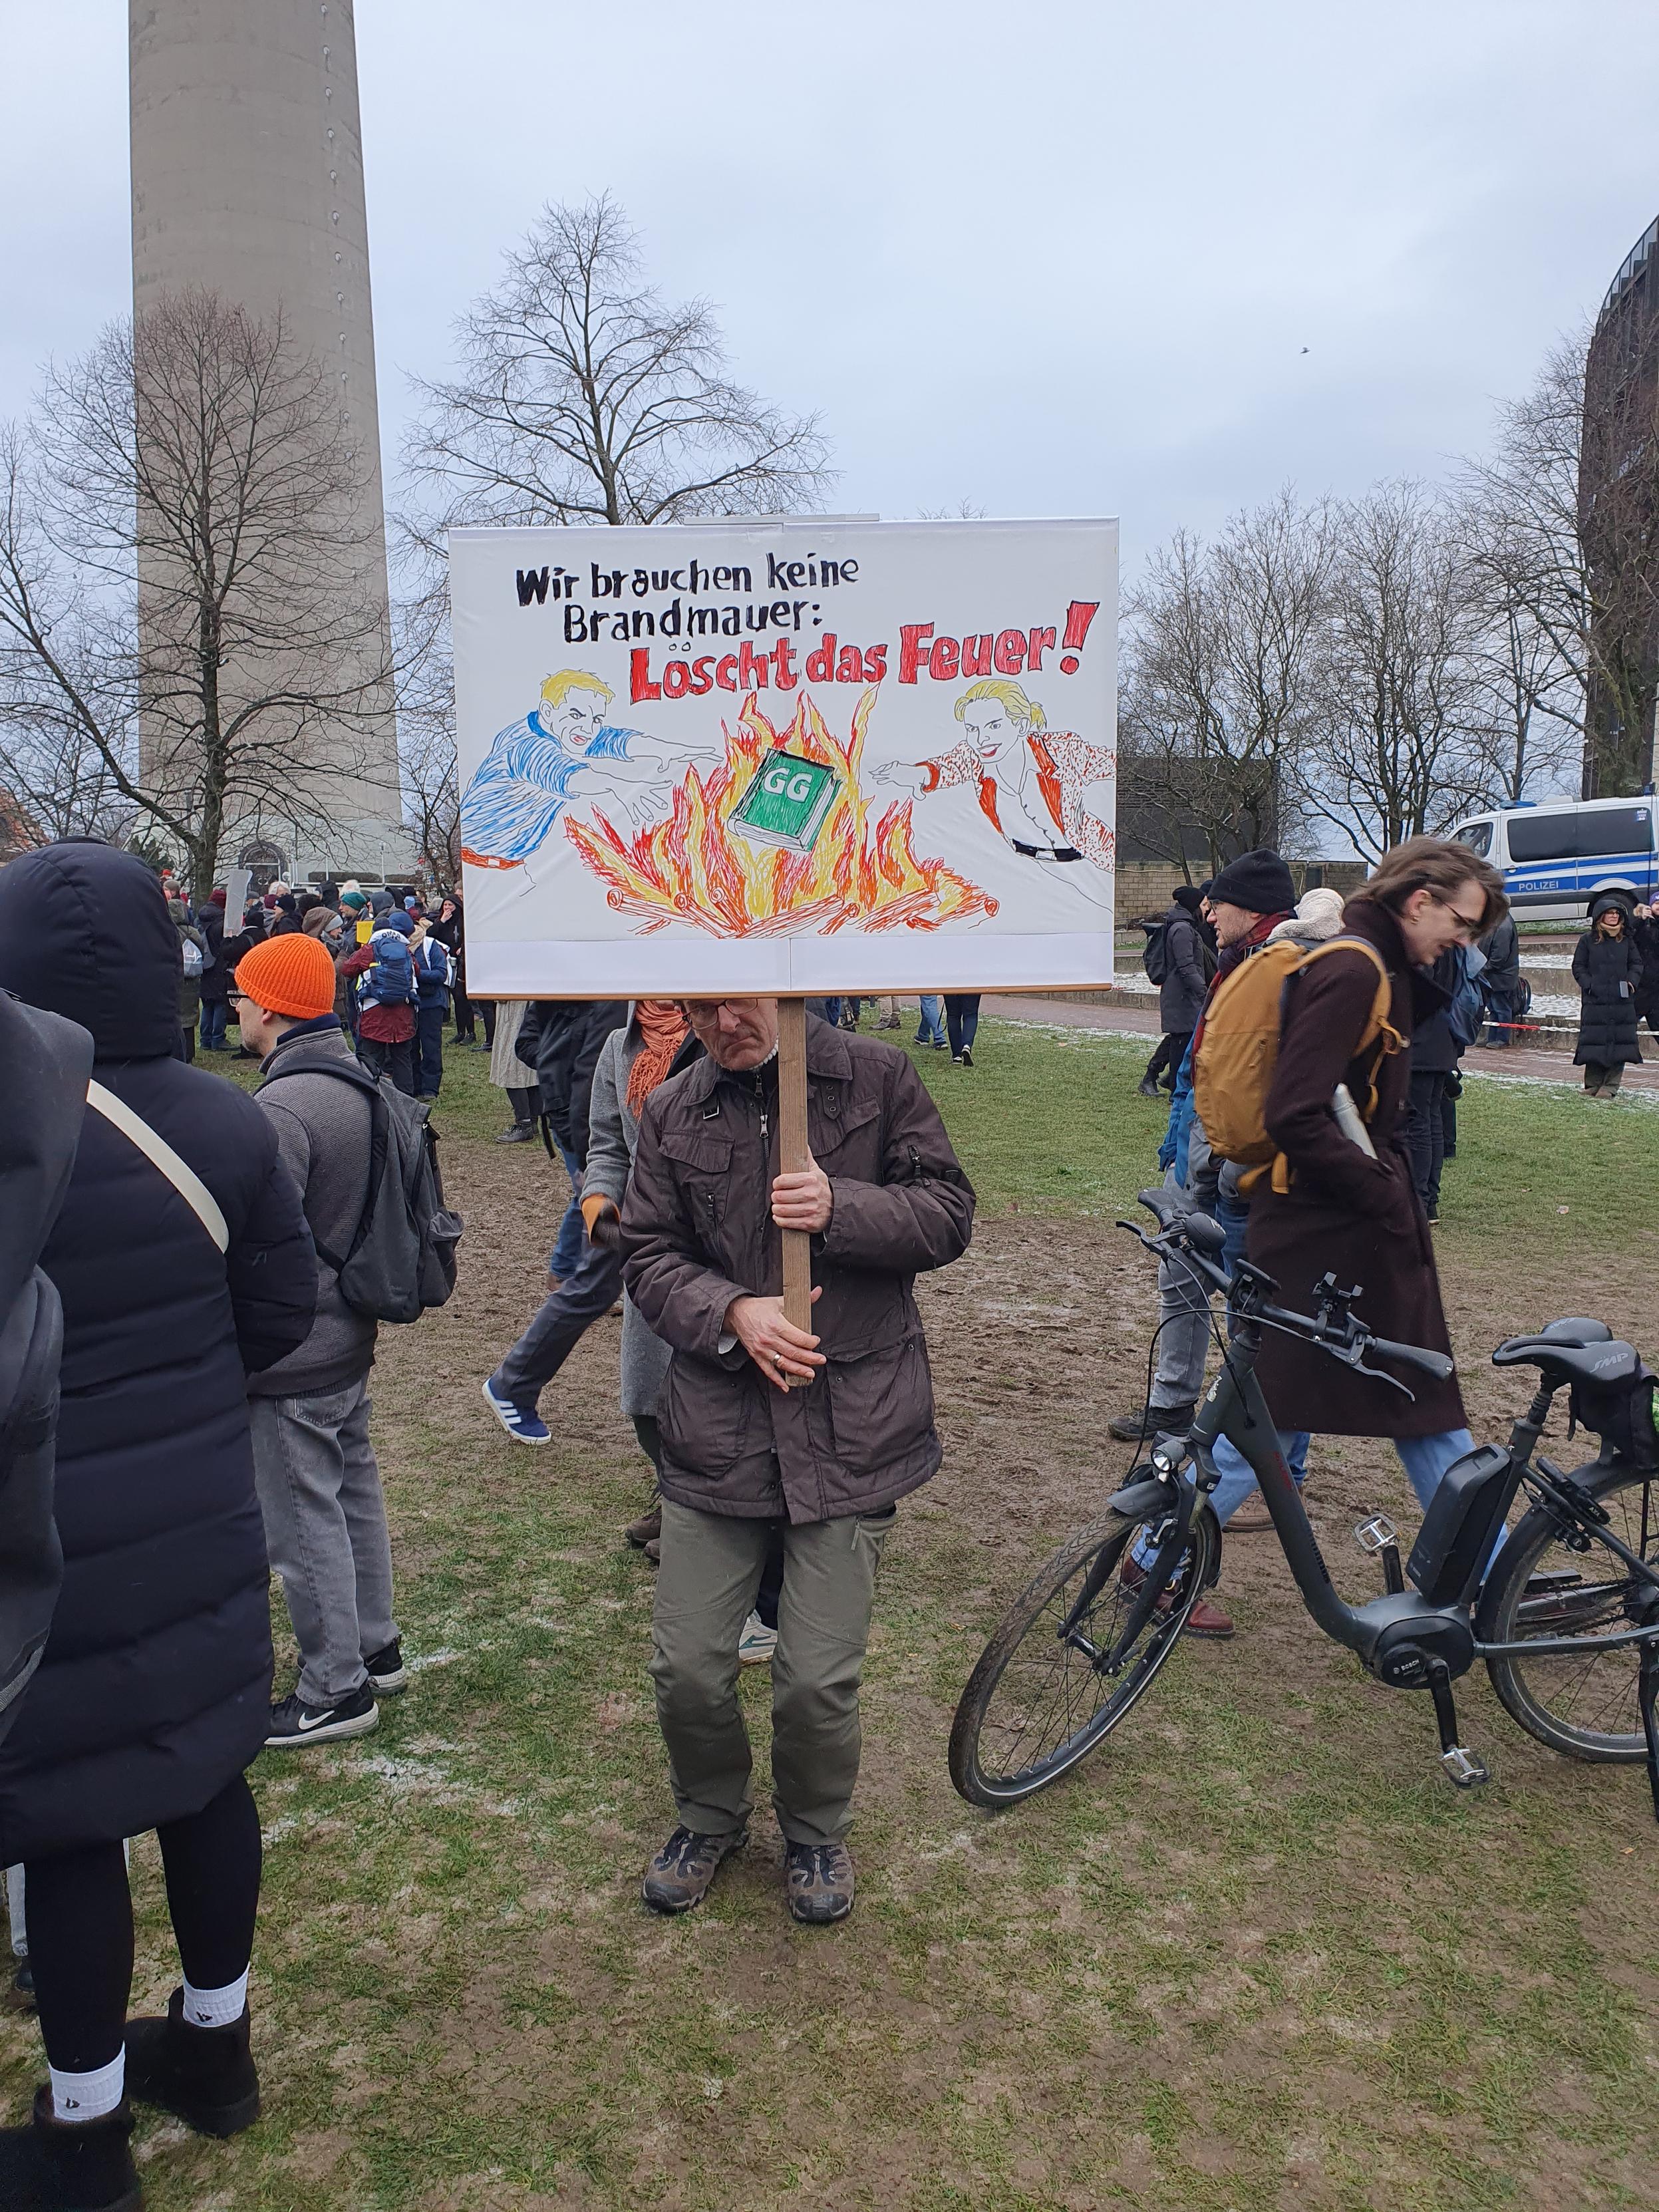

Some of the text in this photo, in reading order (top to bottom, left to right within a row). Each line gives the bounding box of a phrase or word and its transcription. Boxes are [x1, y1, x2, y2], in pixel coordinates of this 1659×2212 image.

[516, 553, 859, 607] Wir brauchen keine
[563, 597, 823, 643] Brandmauer:
[629, 600, 1100, 705] Löscht das Feuer!
[764, 766, 813, 804] GG
[1519, 881, 1559, 891] POLIZEI
